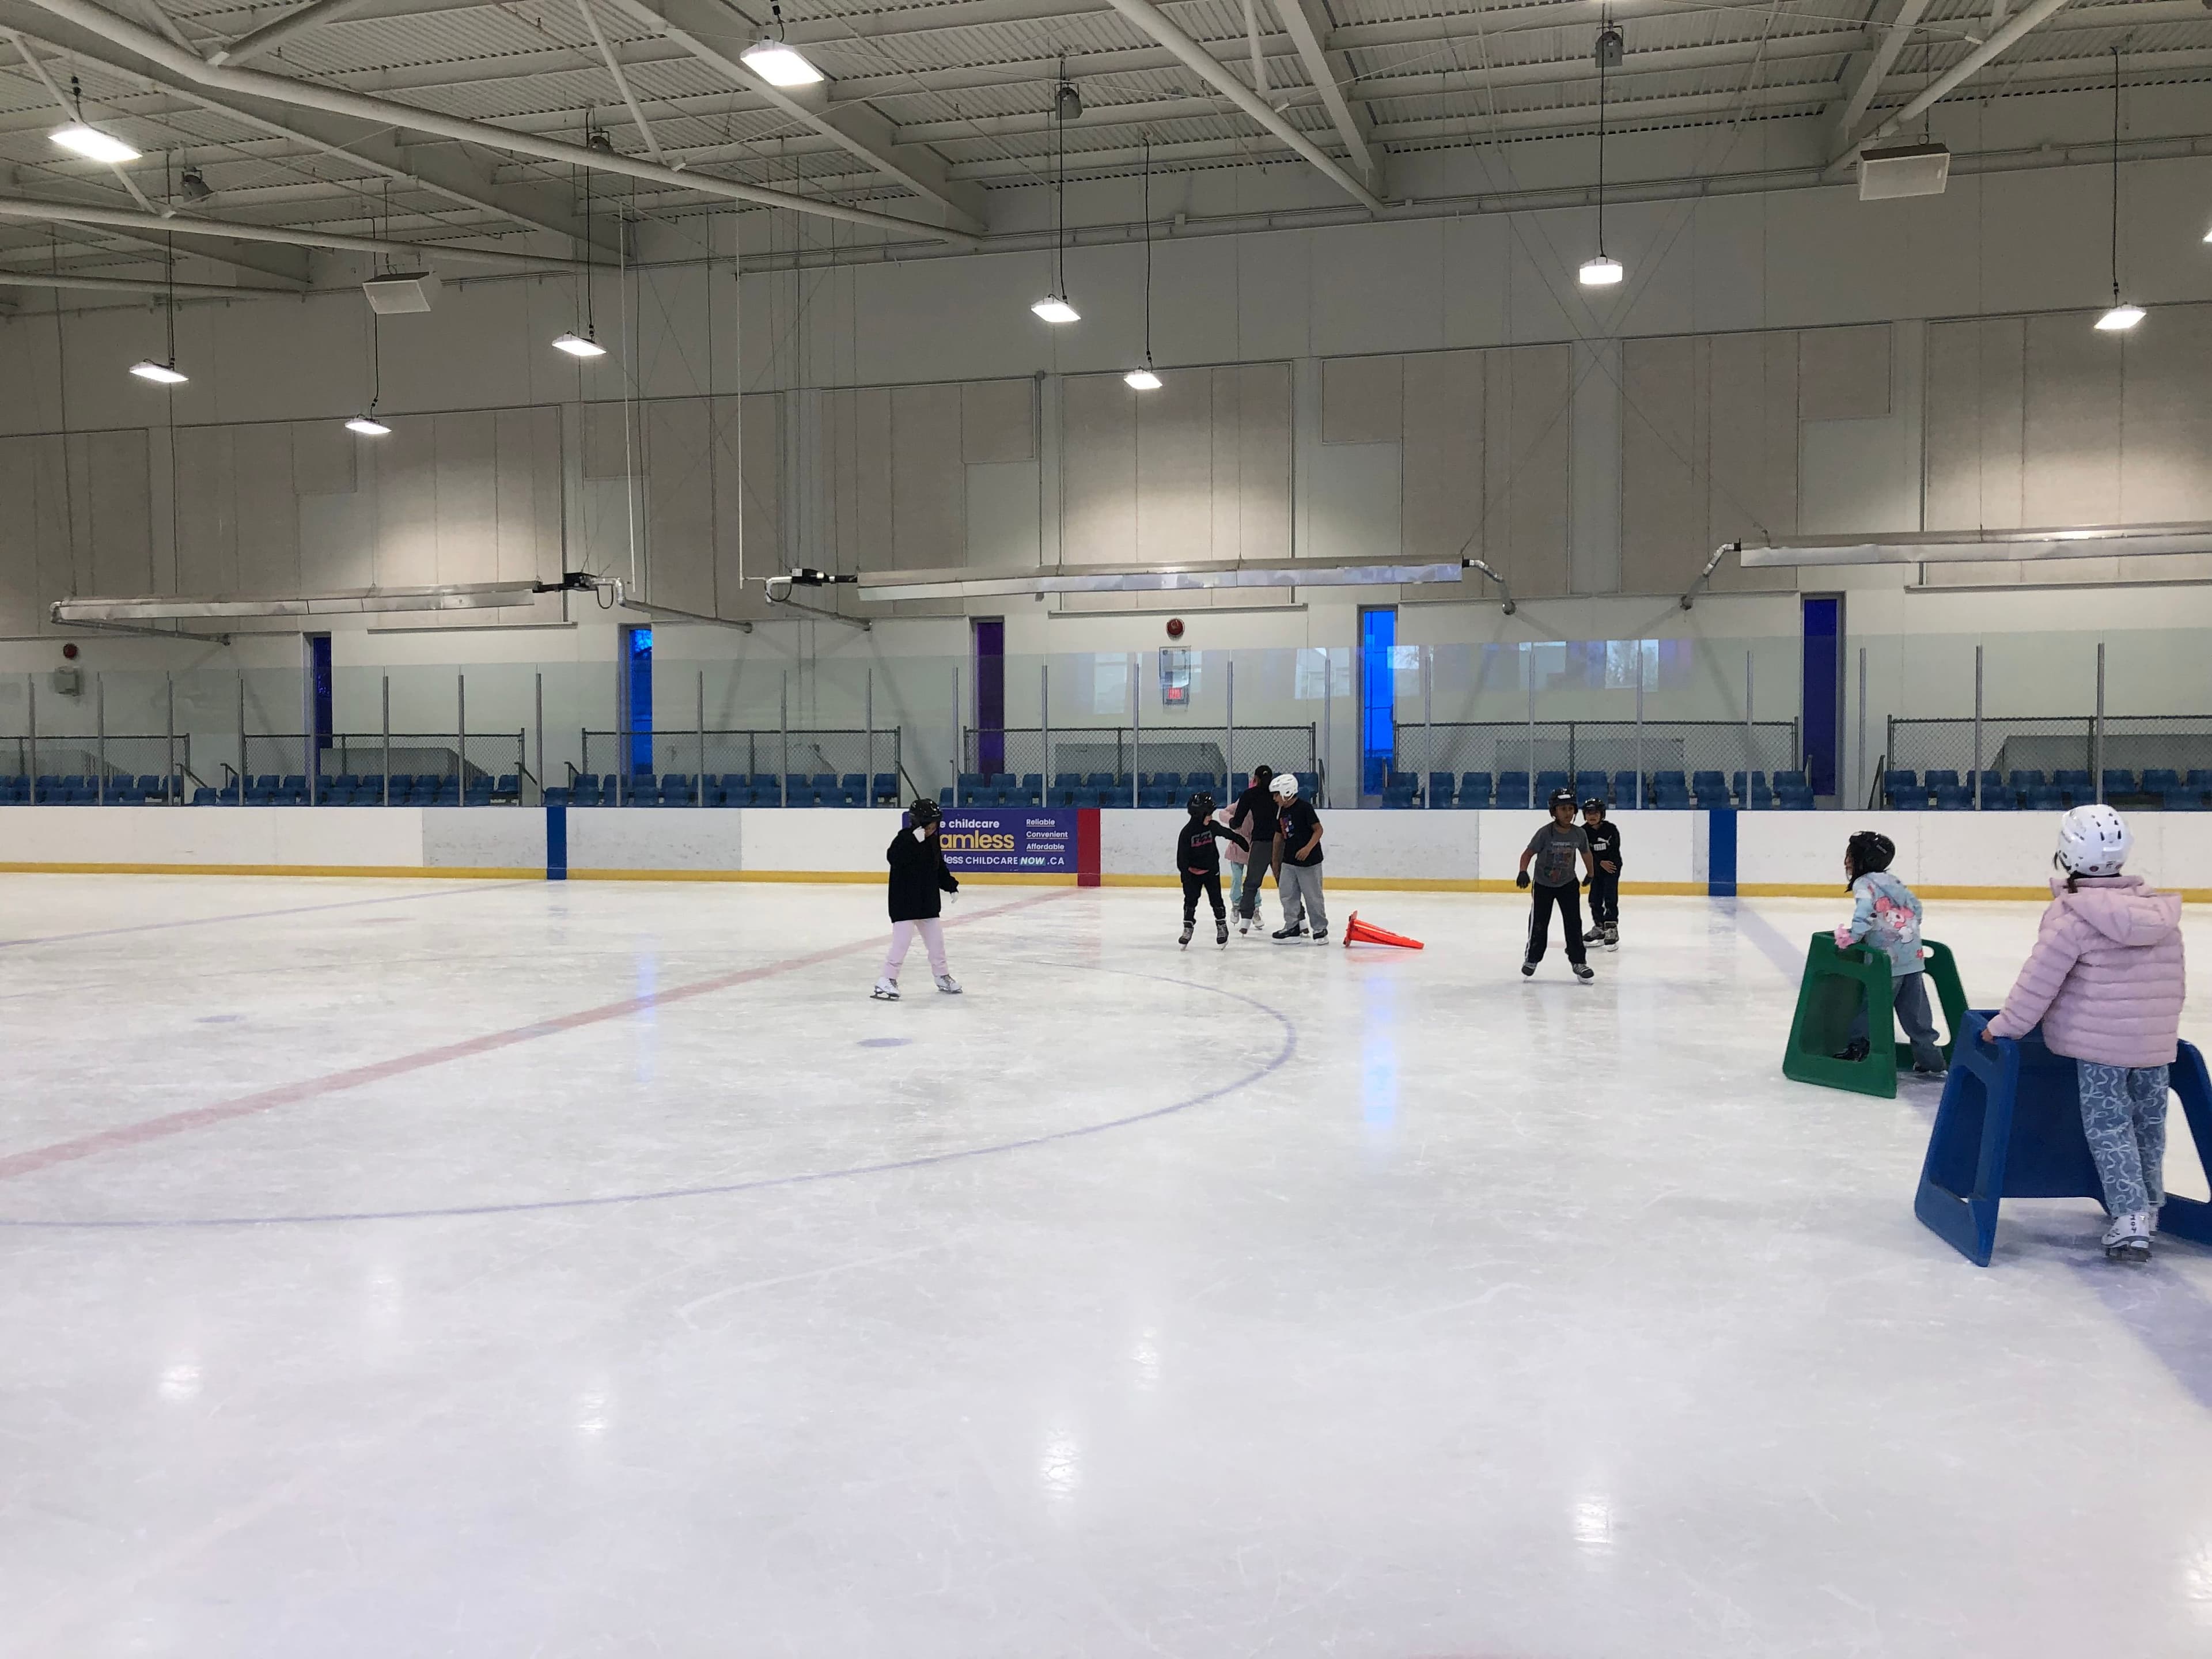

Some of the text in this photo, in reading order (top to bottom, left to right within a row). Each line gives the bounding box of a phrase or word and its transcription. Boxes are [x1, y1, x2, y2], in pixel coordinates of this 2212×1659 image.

[948, 819, 1000, 828] childcare
[940, 830, 1014, 849] amless
[965, 856, 1018, 865] CHILDCARE
[1020, 856, 1046, 865] NOW
[1047, 857, 1065, 865] .CA
